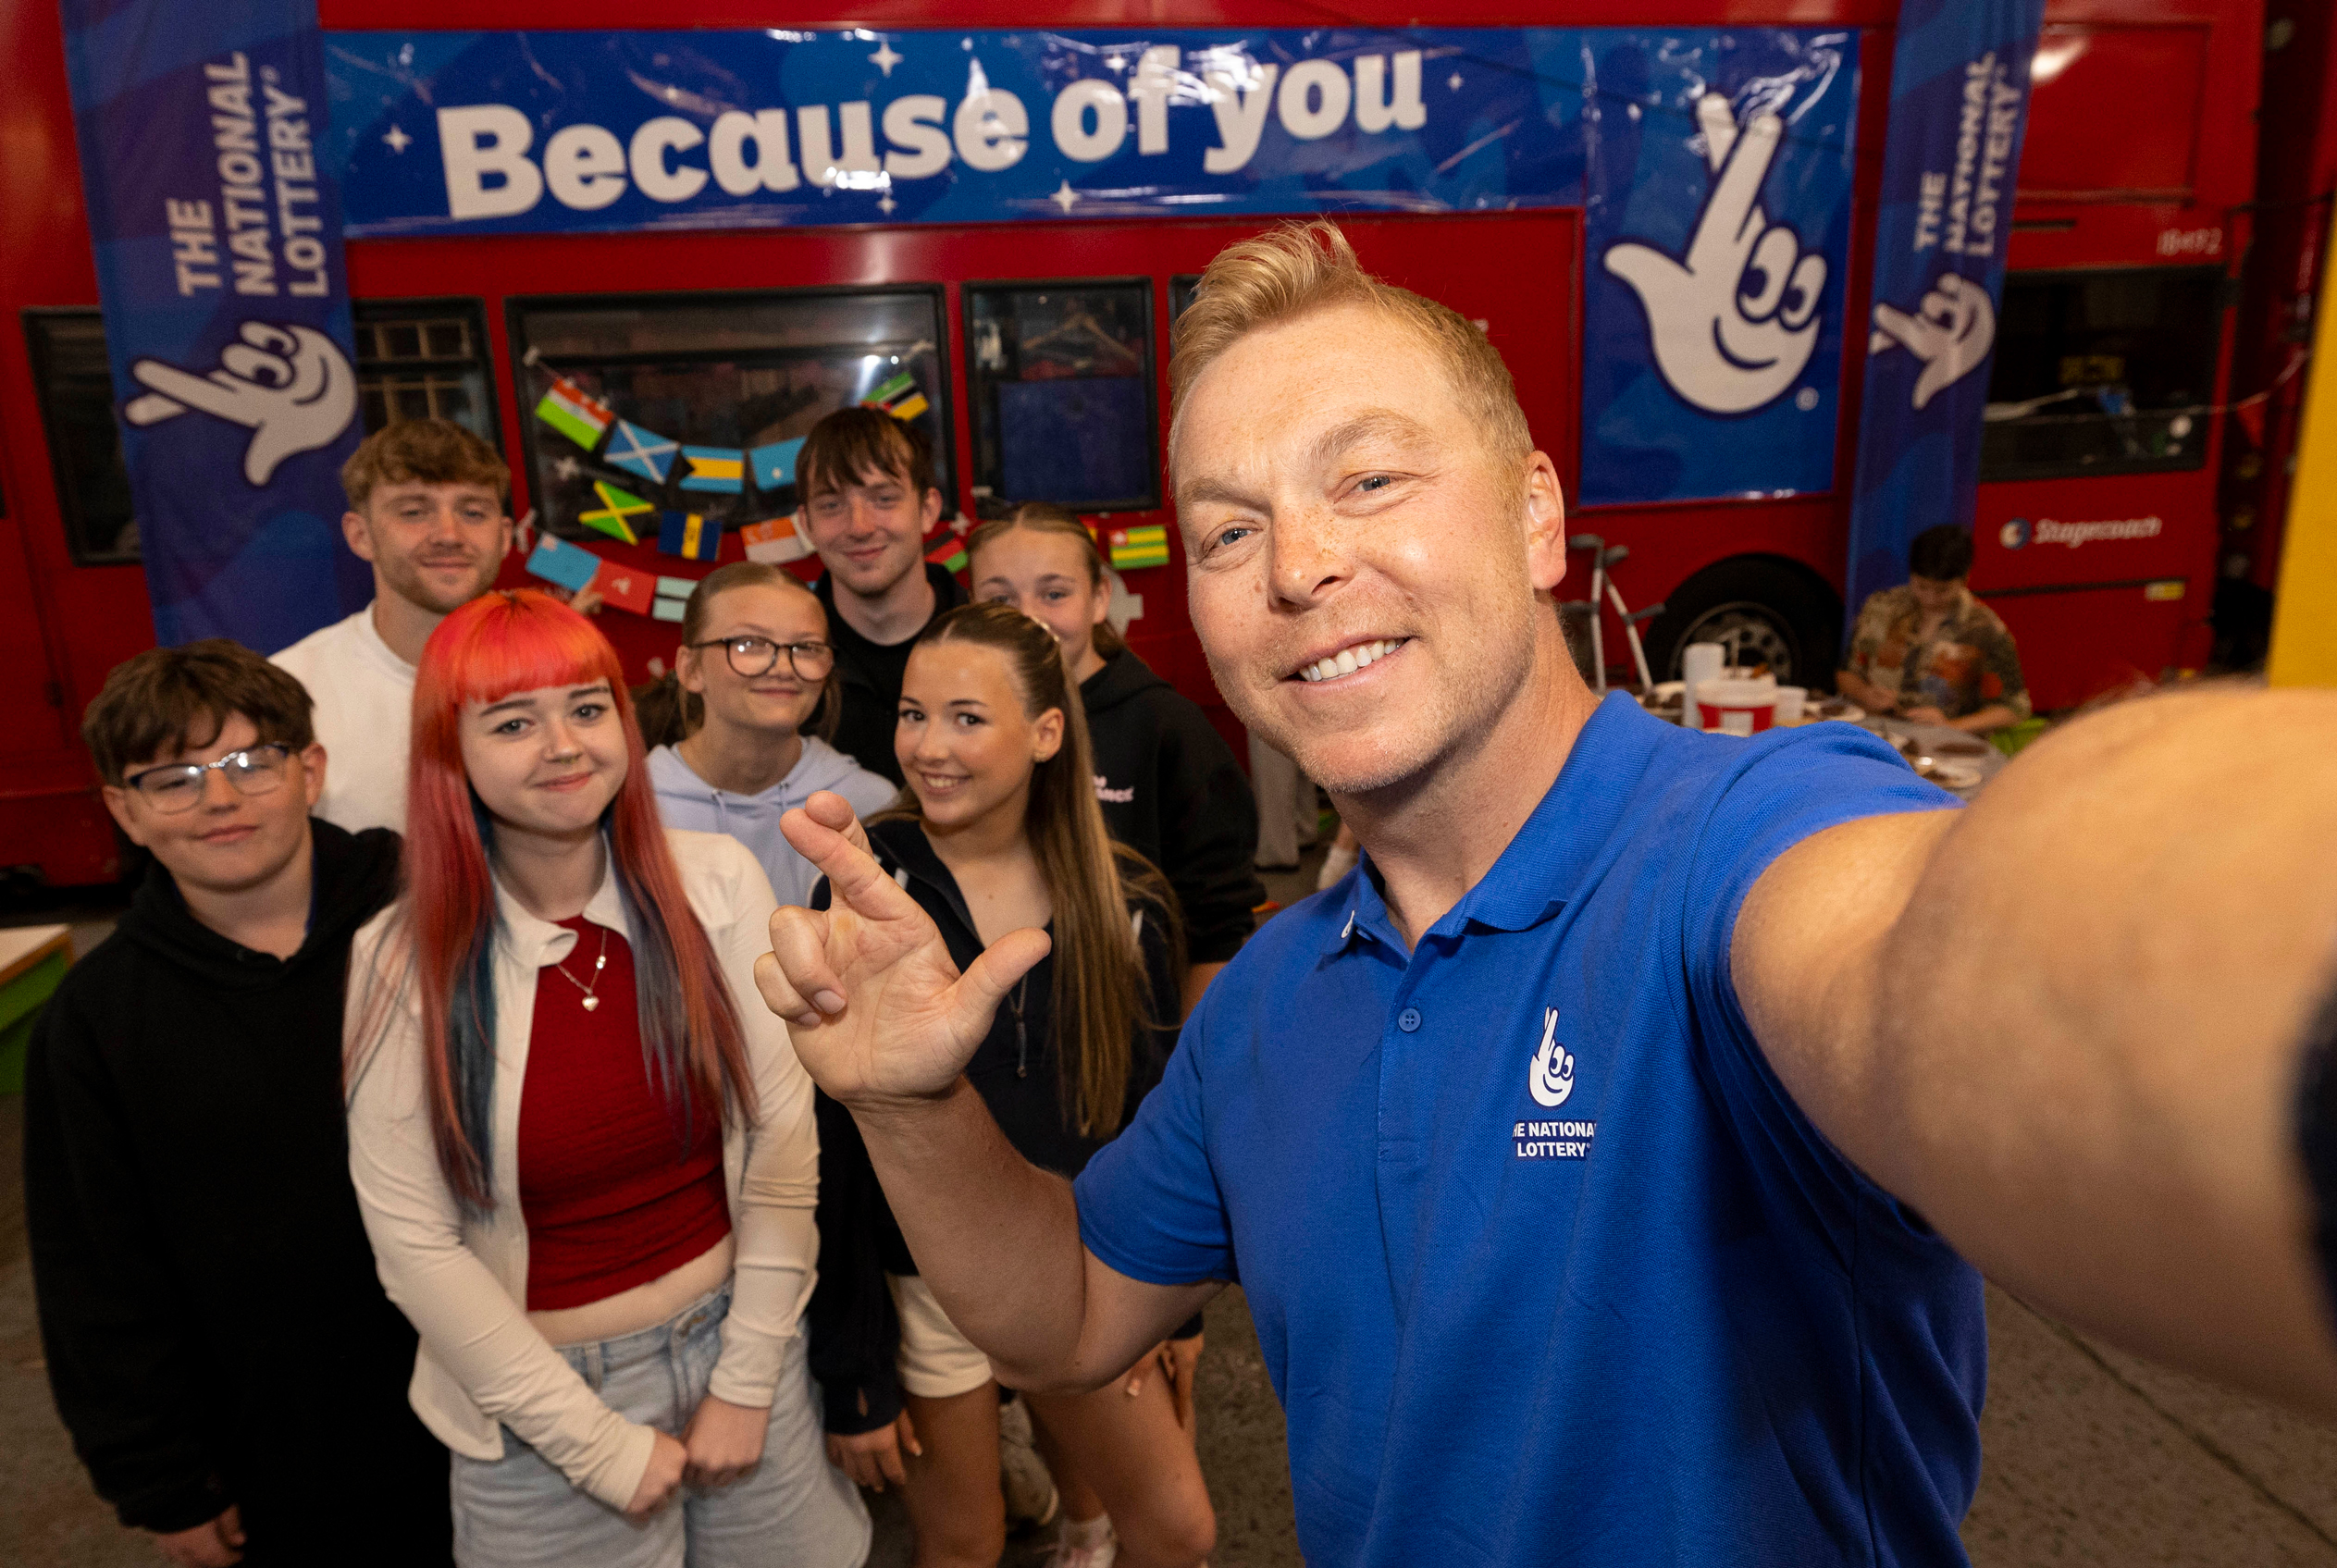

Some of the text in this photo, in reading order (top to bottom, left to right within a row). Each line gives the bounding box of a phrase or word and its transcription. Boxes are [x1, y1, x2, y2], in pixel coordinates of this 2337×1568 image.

[204, 50, 278, 296] NATIONAL
[436, 44, 1428, 221] Because of you
[1945, 51, 1997, 253] NATIONAL
[165, 197, 223, 297] THE
[1913, 170, 1948, 253] THE
[2033, 514, 2163, 549] Stagecoach
[1517, 1142, 1586, 1157] LOTTERY
[1528, 1121, 1596, 1138] NATIONA
